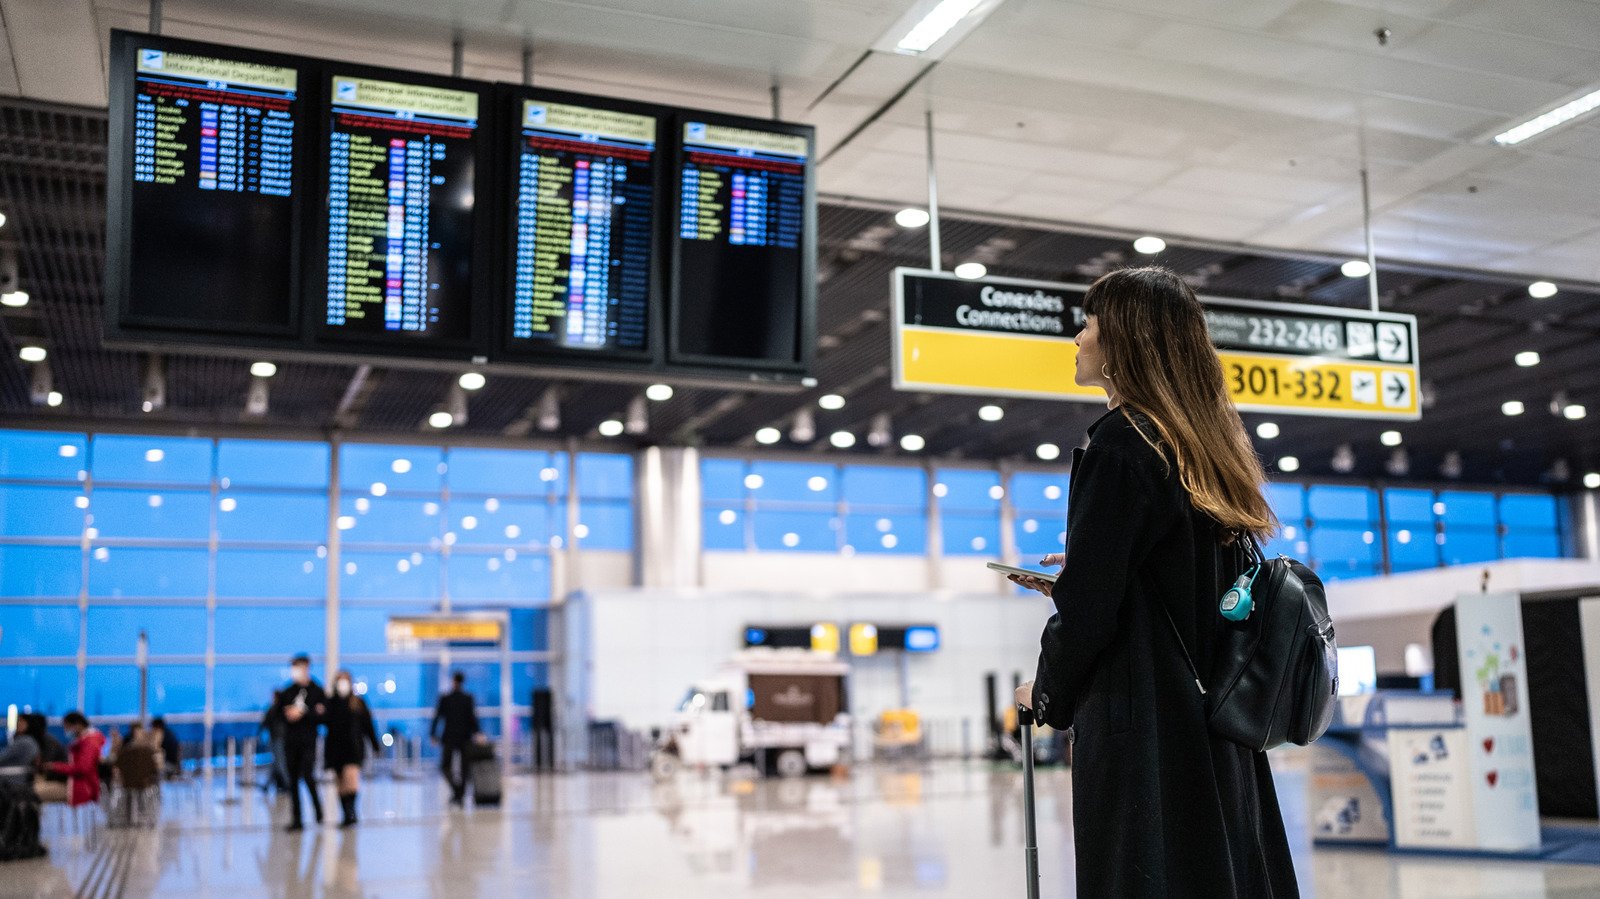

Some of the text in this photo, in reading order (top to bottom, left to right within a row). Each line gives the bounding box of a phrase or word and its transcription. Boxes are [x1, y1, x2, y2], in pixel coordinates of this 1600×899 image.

[980, 285, 1065, 313] Conexões
[956, 304, 1064, 334] Connections
[1248, 316, 1339, 351] 232-246
[1230, 363, 1342, 401] 301-332
